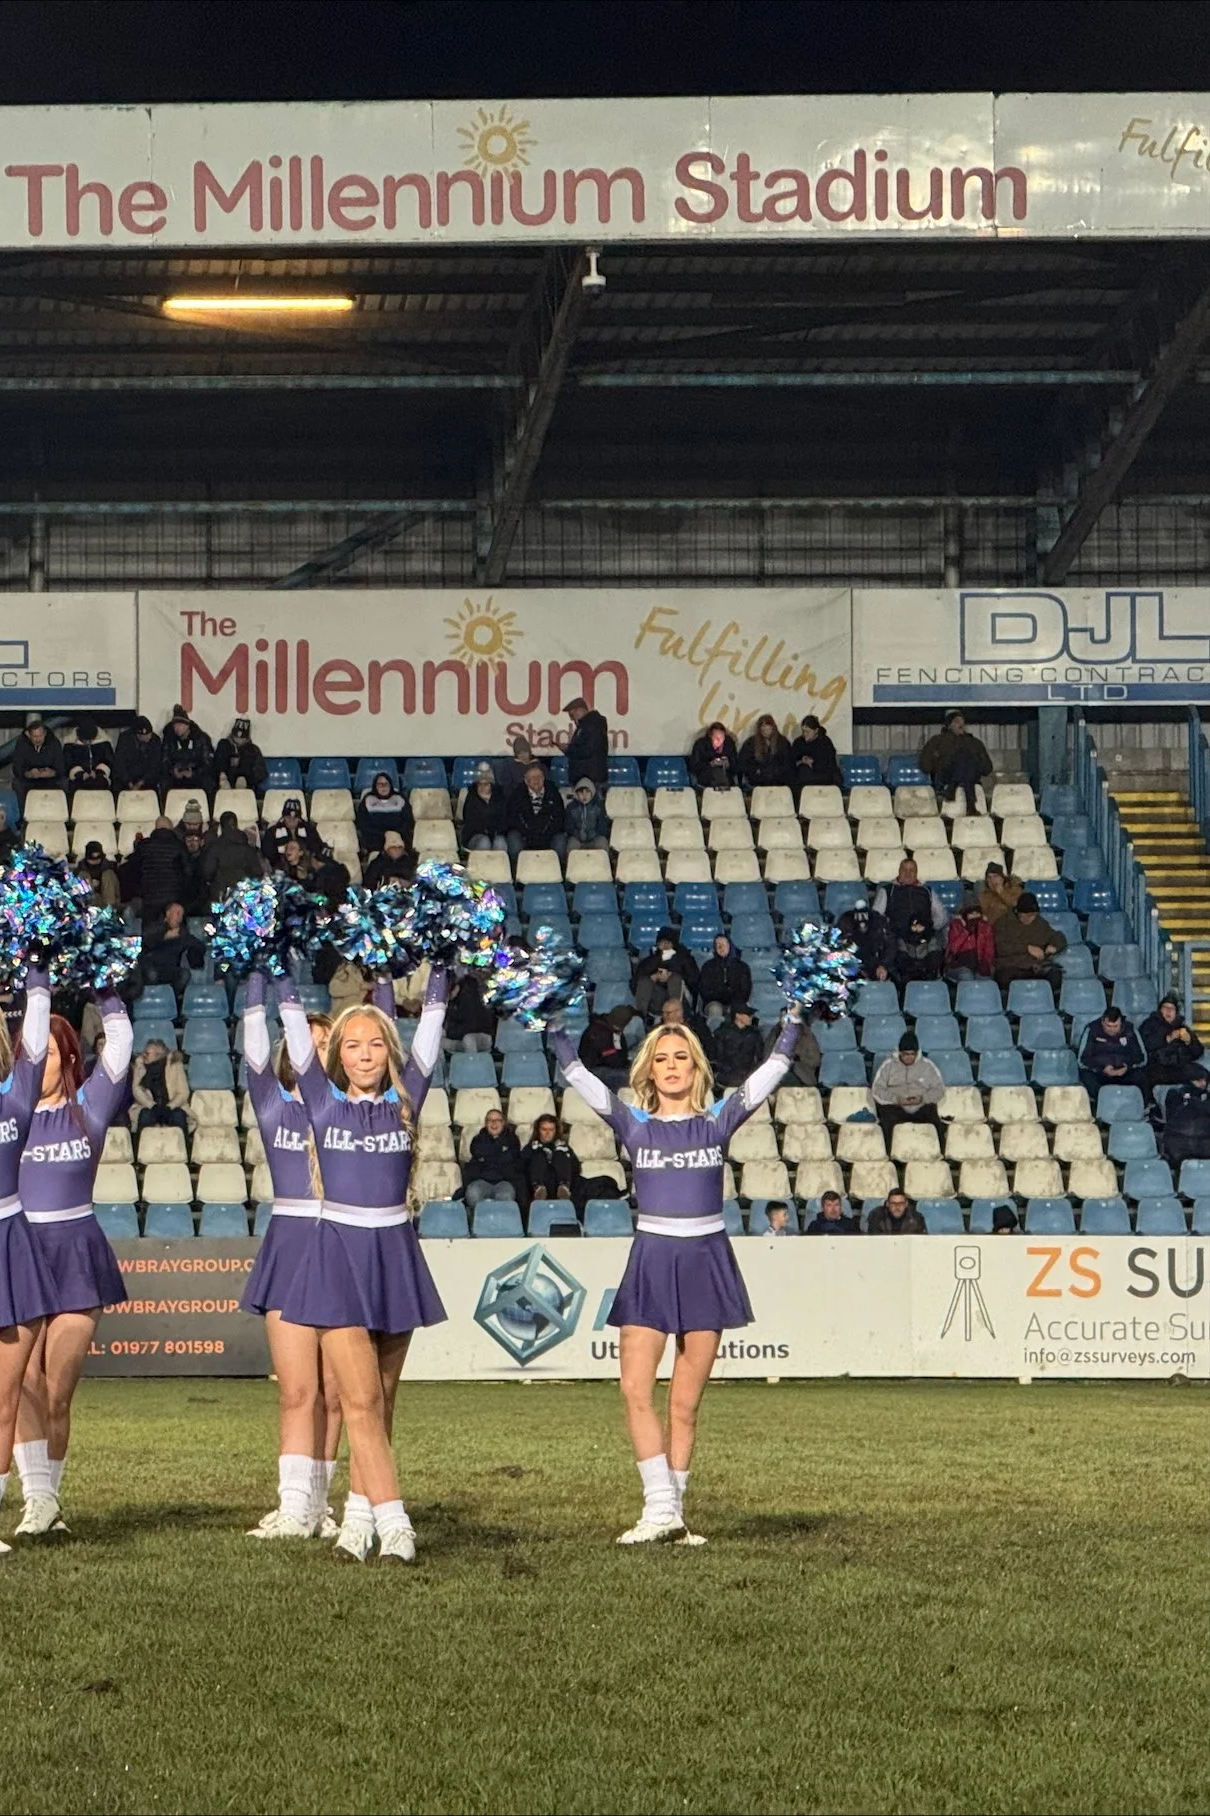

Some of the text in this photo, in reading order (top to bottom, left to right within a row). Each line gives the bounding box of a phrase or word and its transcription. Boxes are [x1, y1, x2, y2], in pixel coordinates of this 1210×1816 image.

[1118, 118, 1210, 179] Fulfi
[5, 149, 1027, 237] The Millennium Stadium
[180, 610, 236, 638] The
[960, 592, 1210, 664] DJL
[181, 638, 628, 716] Millennium
[635, 607, 847, 725] Fulfilling
[877, 667, 1206, 683] FENCING CONTRAC
[1047, 684, 1128, 700] LTD
[506, 722, 629, 749] Stadm
[20, 1136, 91, 1162] -STARS
[324, 1126, 411, 1153] ALL-STAR
[636, 1146, 723, 1169] ALL-STARS
[117, 1259, 255, 1273] WBRAYGROUP.C
[1026, 1247, 1204, 1298] ZS SU
[102, 1300, 241, 1313] OWBRAYGROUP.
[1024, 1313, 1160, 1340] Accurate
[110, 1341, 159, 1354] 01977
[164, 1341, 224, 1354] 801598
[715, 1340, 789, 1359] utions
[1024, 1348, 1196, 1366] info@zssurveys.com
